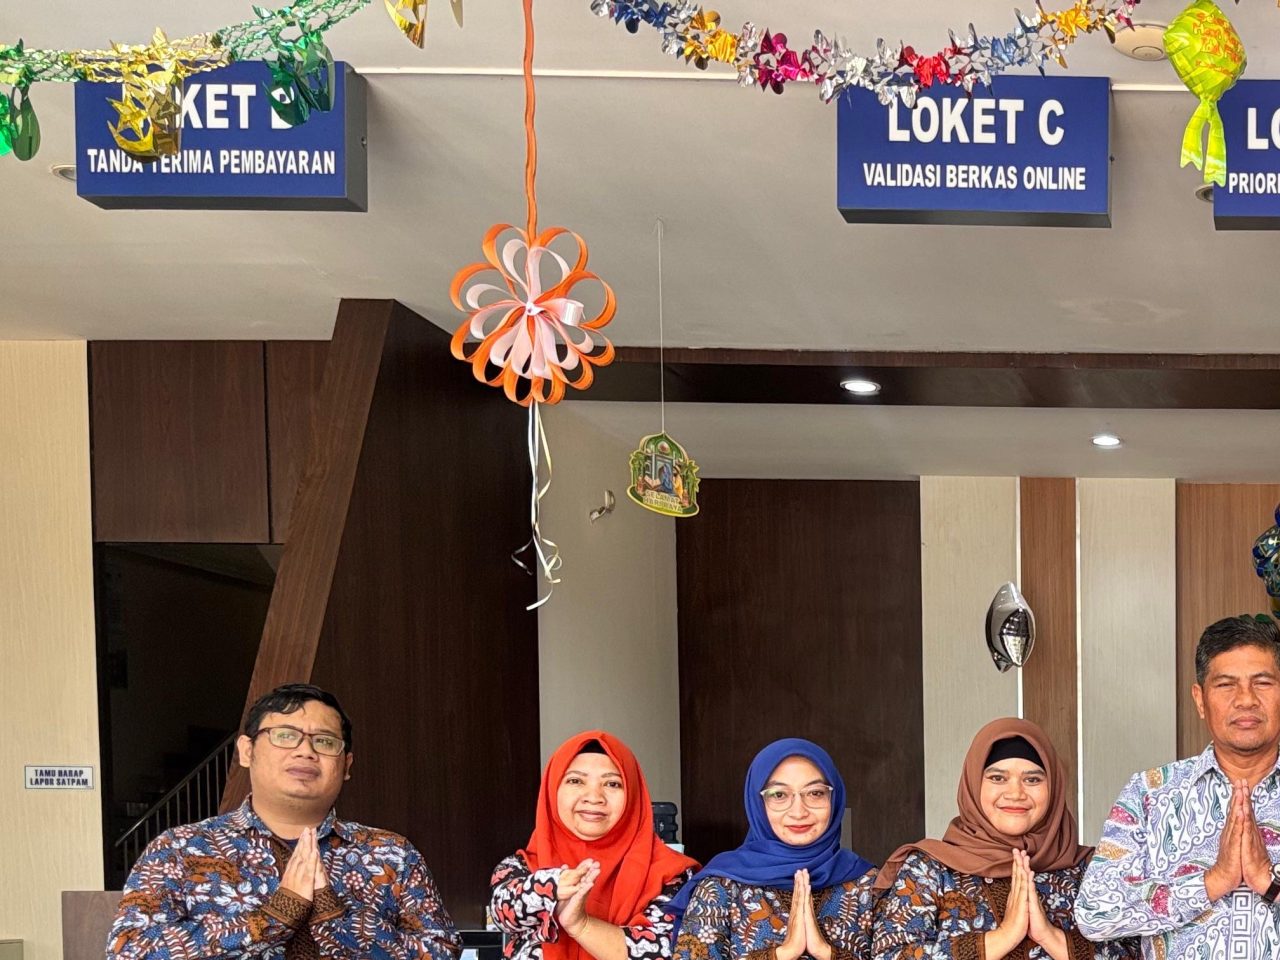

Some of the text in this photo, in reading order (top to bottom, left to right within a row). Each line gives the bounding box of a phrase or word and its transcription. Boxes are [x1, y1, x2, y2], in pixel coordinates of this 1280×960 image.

[122, 83, 257, 129] KET
[888, 96, 1065, 146] LOKET C
[87, 149, 144, 173] TANDA
[220, 151, 336, 175] PEMBAYARAN
[863, 163, 1086, 191] VALIDASI BERKAS ONLINE
[56, 778, 88, 786] SATPAM
